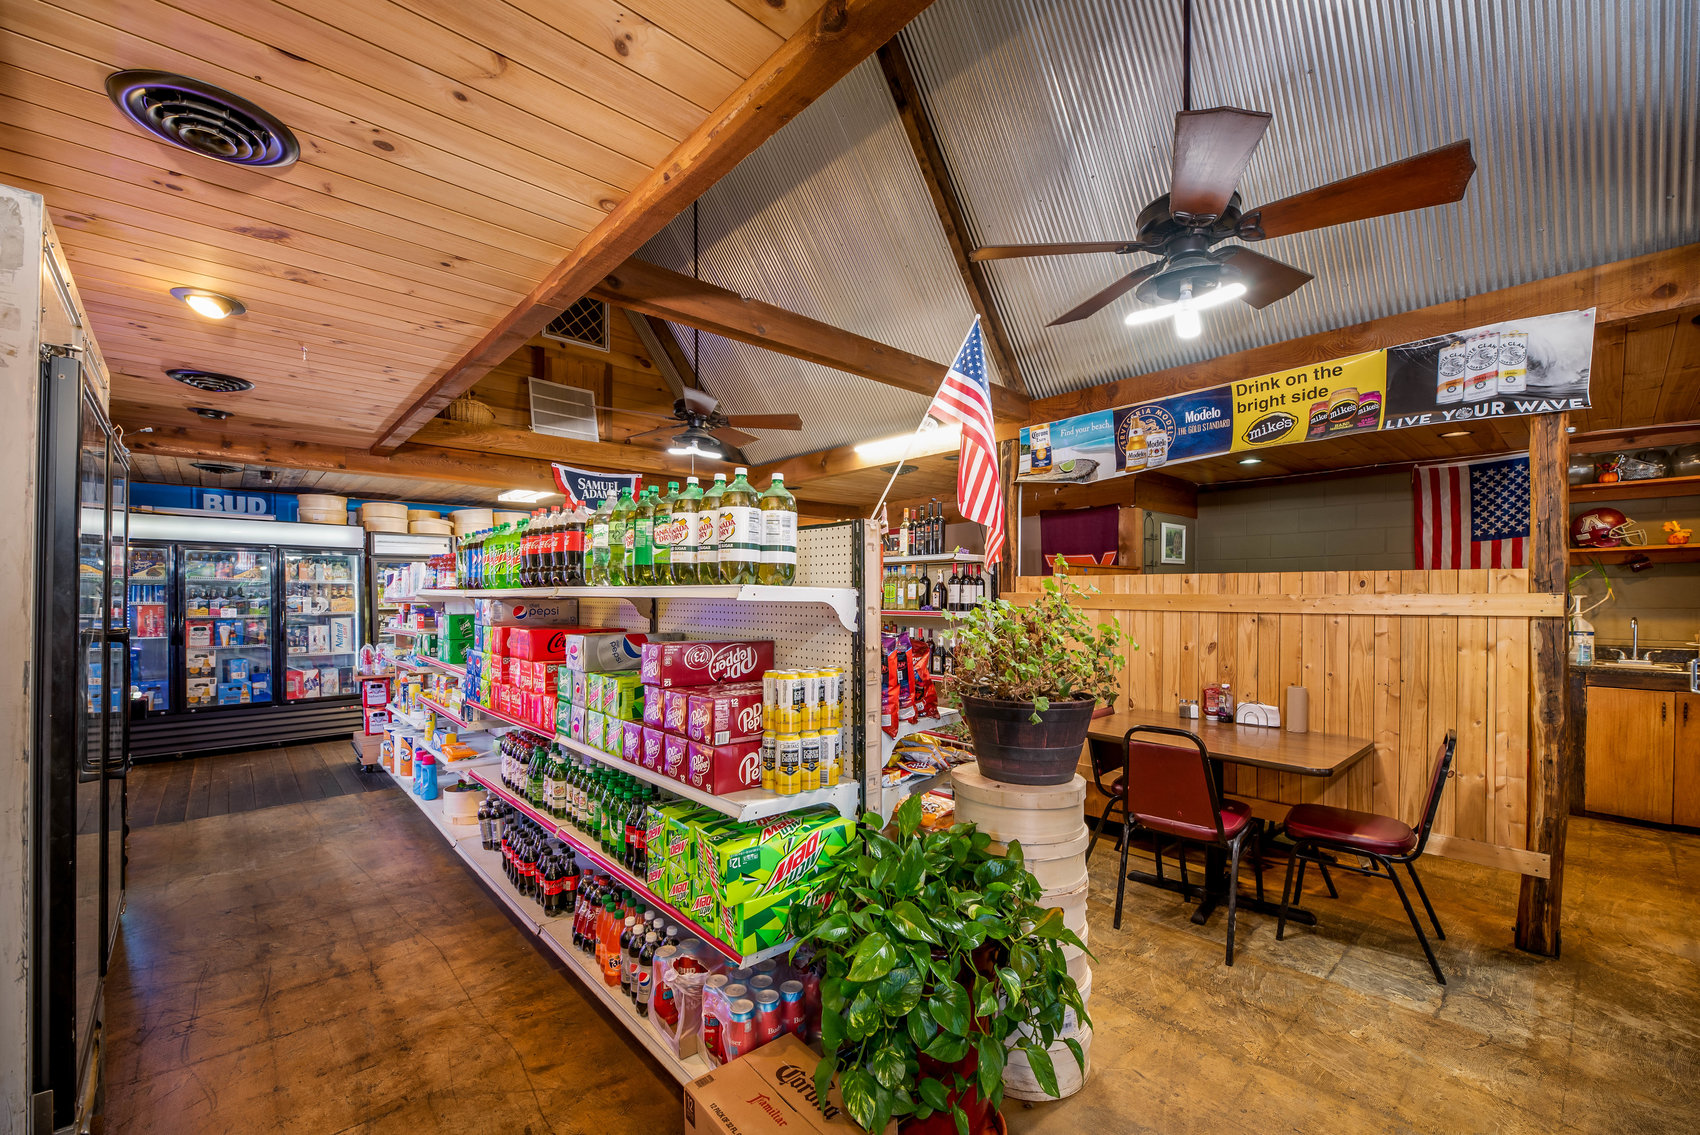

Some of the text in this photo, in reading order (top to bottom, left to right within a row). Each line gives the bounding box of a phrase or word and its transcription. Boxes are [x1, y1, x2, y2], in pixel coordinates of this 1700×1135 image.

[1236, 365, 1344, 397] Drink on the
[1237, 386, 1329, 414] bright side
[1185, 406, 1222, 424] Modelo
[1329, 403, 1358, 420] mike's
[1385, 397, 1584, 430] LIVE YOUR WAVE
[1060, 427, 1074, 438] Find
[1075, 425, 1091, 438] your
[1177, 418, 1231, 436] THE GOLD STANDARD
[1248, 418, 1294, 441] mike's
[577, 477, 622, 494] SAMUEL
[202, 493, 267, 515] BUD
[582, 491, 614, 501] ADAM
[528, 606, 560, 618] pepsi
[609, 641, 624, 664] pepsi
[731, 857, 741, 868] 12
[609, 957, 622, 969] Fan
[713, 1107, 726, 1119] PACK
[745, 1092, 788, 1127] Familiar
